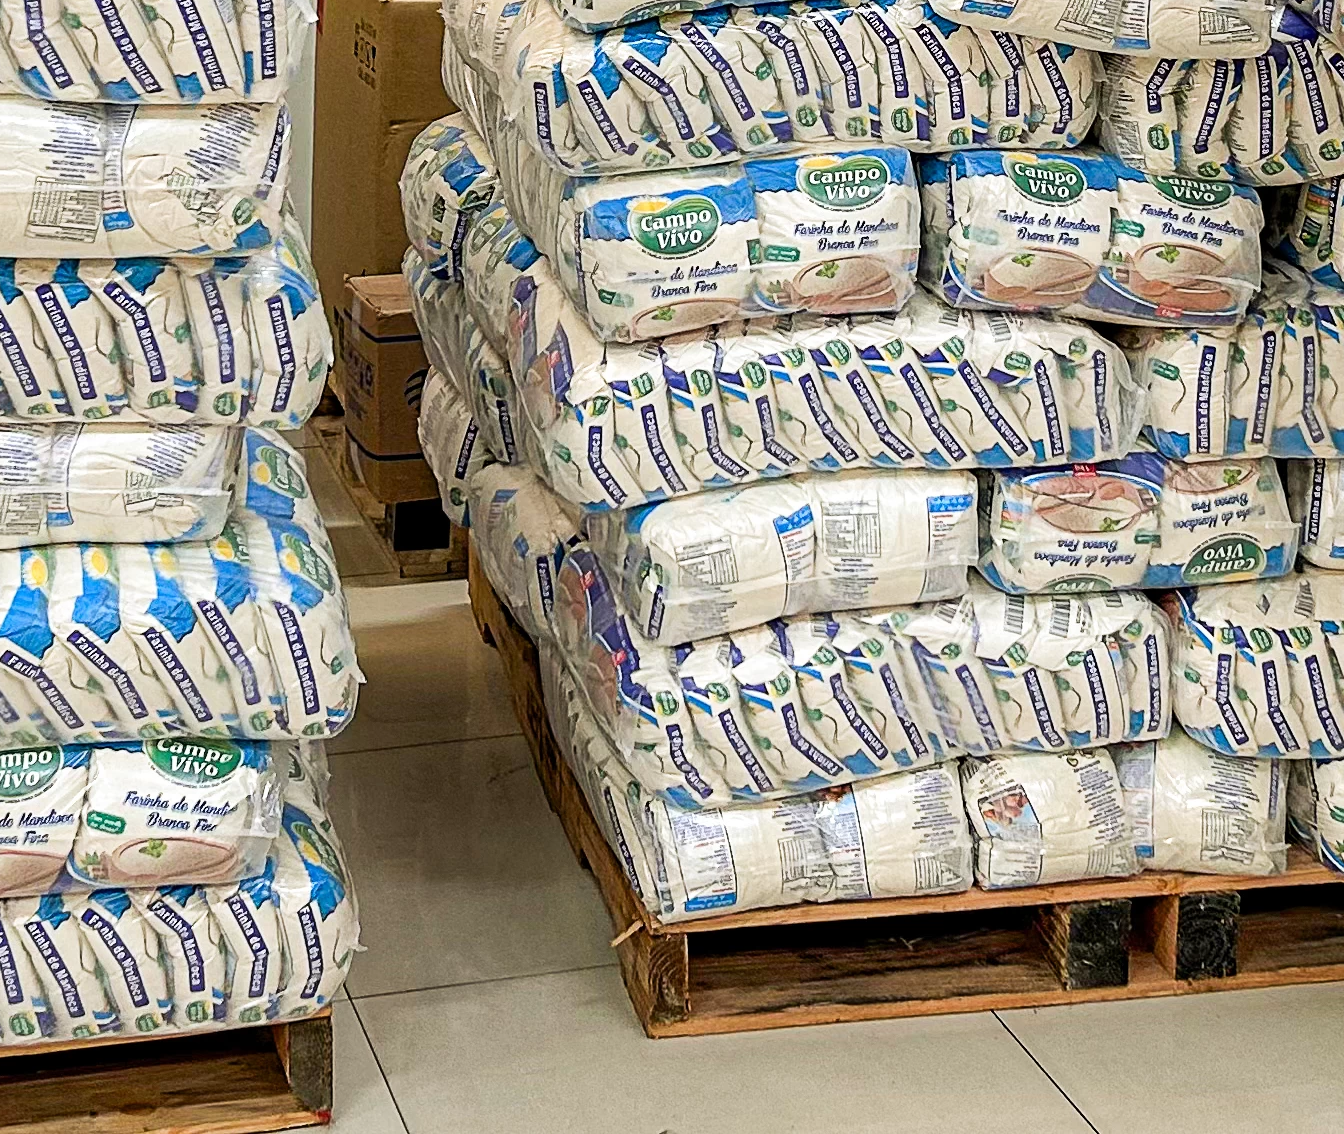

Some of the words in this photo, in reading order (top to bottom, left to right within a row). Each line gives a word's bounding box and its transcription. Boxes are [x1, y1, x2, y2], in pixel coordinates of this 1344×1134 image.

[783, 41, 805, 91] Mandioca
[888, 44, 905, 93] Mandioca
[721, 68, 749, 116] Mandioca
[1307, 79, 1326, 128] Mandioca
[808, 167, 881, 186] Campo
[1013, 161, 1078, 187] Campo
[824, 182, 870, 201] Vivo
[1027, 179, 1071, 200] Vivo
[1171, 184, 1217, 204] Vivo
[640, 208, 713, 233] Campo
[996, 209, 1036, 228] Farinha
[1038, 216, 1053, 230] de
[1140, 203, 1180, 223] Farinha
[1183, 212, 1197, 226] de
[656, 229, 703, 250] Vivo
[793, 222, 834, 237] Farinha
[837, 224, 852, 235] de
[1017, 227, 1056, 245] Branca
[1162, 221, 1199, 241] Branca
[817, 237, 856, 252] Branca
[671, 268, 685, 281] de
[688, 262, 738, 279] Mandioca
[651, 283, 691, 299] Branca
[6, 345, 35, 392] Mandioca
[1259, 335, 1276, 384] Mandioca
[1198, 353, 1214, 402] Mandioca
[1198, 402, 1209, 418] de
[1253, 399, 1269, 439] Farinha
[1198, 419, 1208, 453] Farinha
[1202, 543, 1244, 562] Vivo
[1189, 556, 1257, 575] Campo
[203, 603, 229, 642] Farinha
[74, 635, 109, 670] Farinha
[295, 659, 316, 709] Mandioca
[170, 754, 219, 778] Vivo
[124, 790, 167, 810] Farinha
[171, 797, 189, 813] de
[146, 812, 192, 832] Branca
